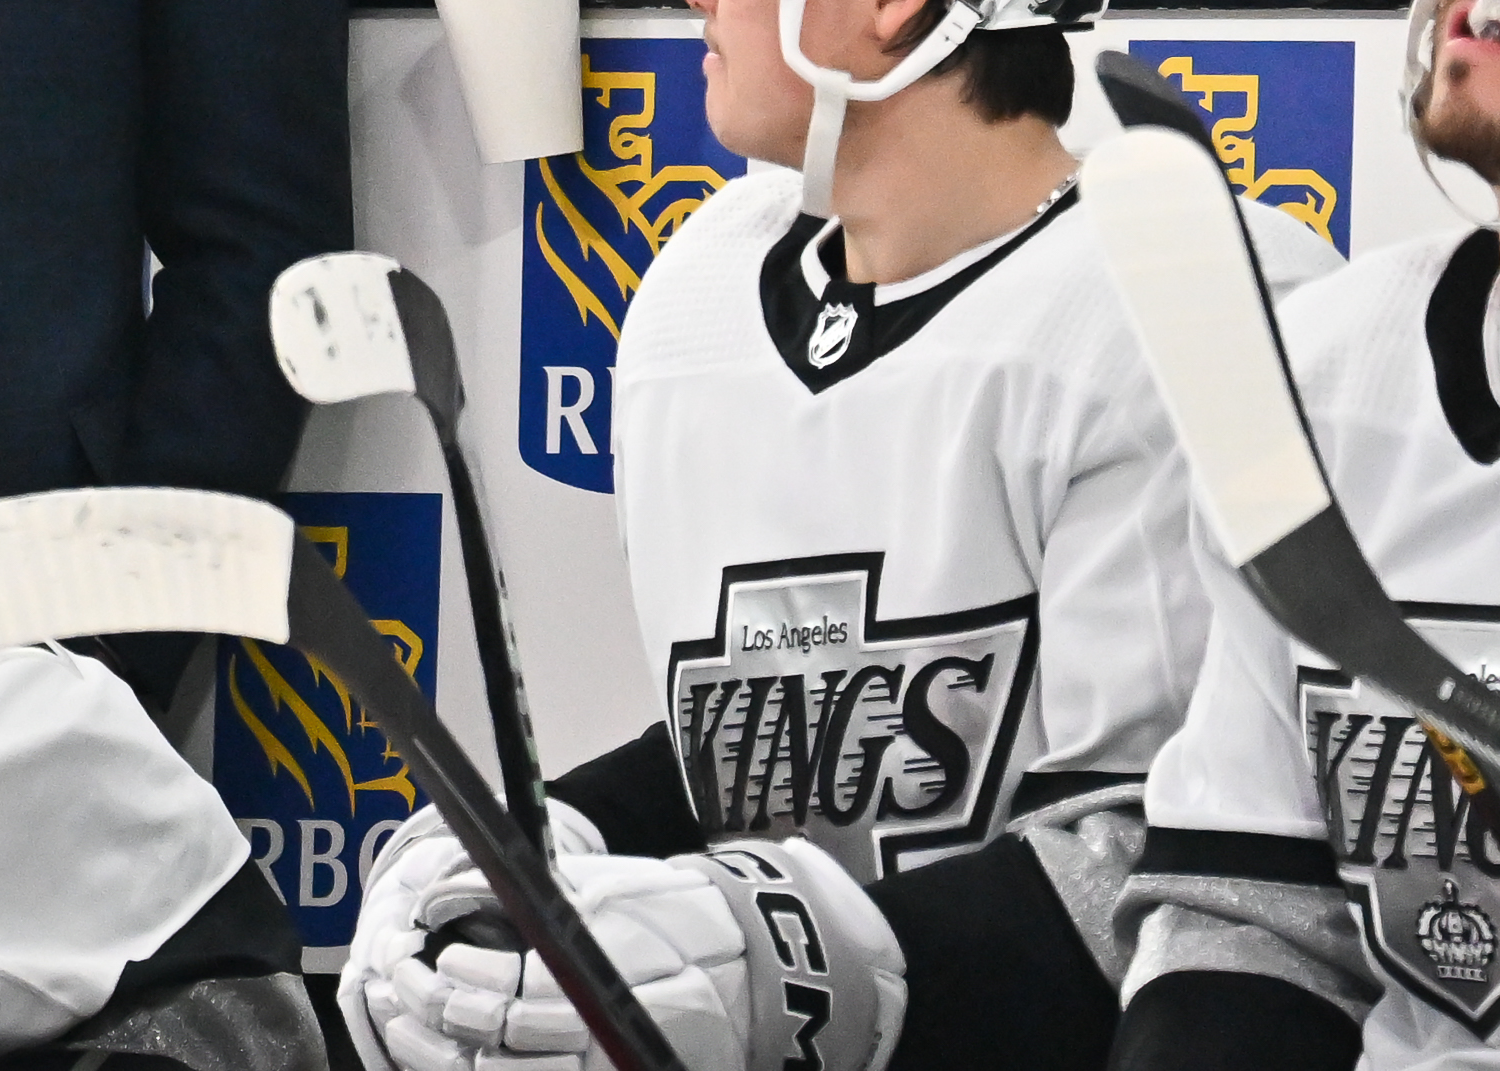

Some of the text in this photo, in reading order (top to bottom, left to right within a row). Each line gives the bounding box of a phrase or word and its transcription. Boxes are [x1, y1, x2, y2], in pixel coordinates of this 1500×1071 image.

[741, 615, 849, 654] Los Angeles
[682, 651, 996, 833] KINGS
